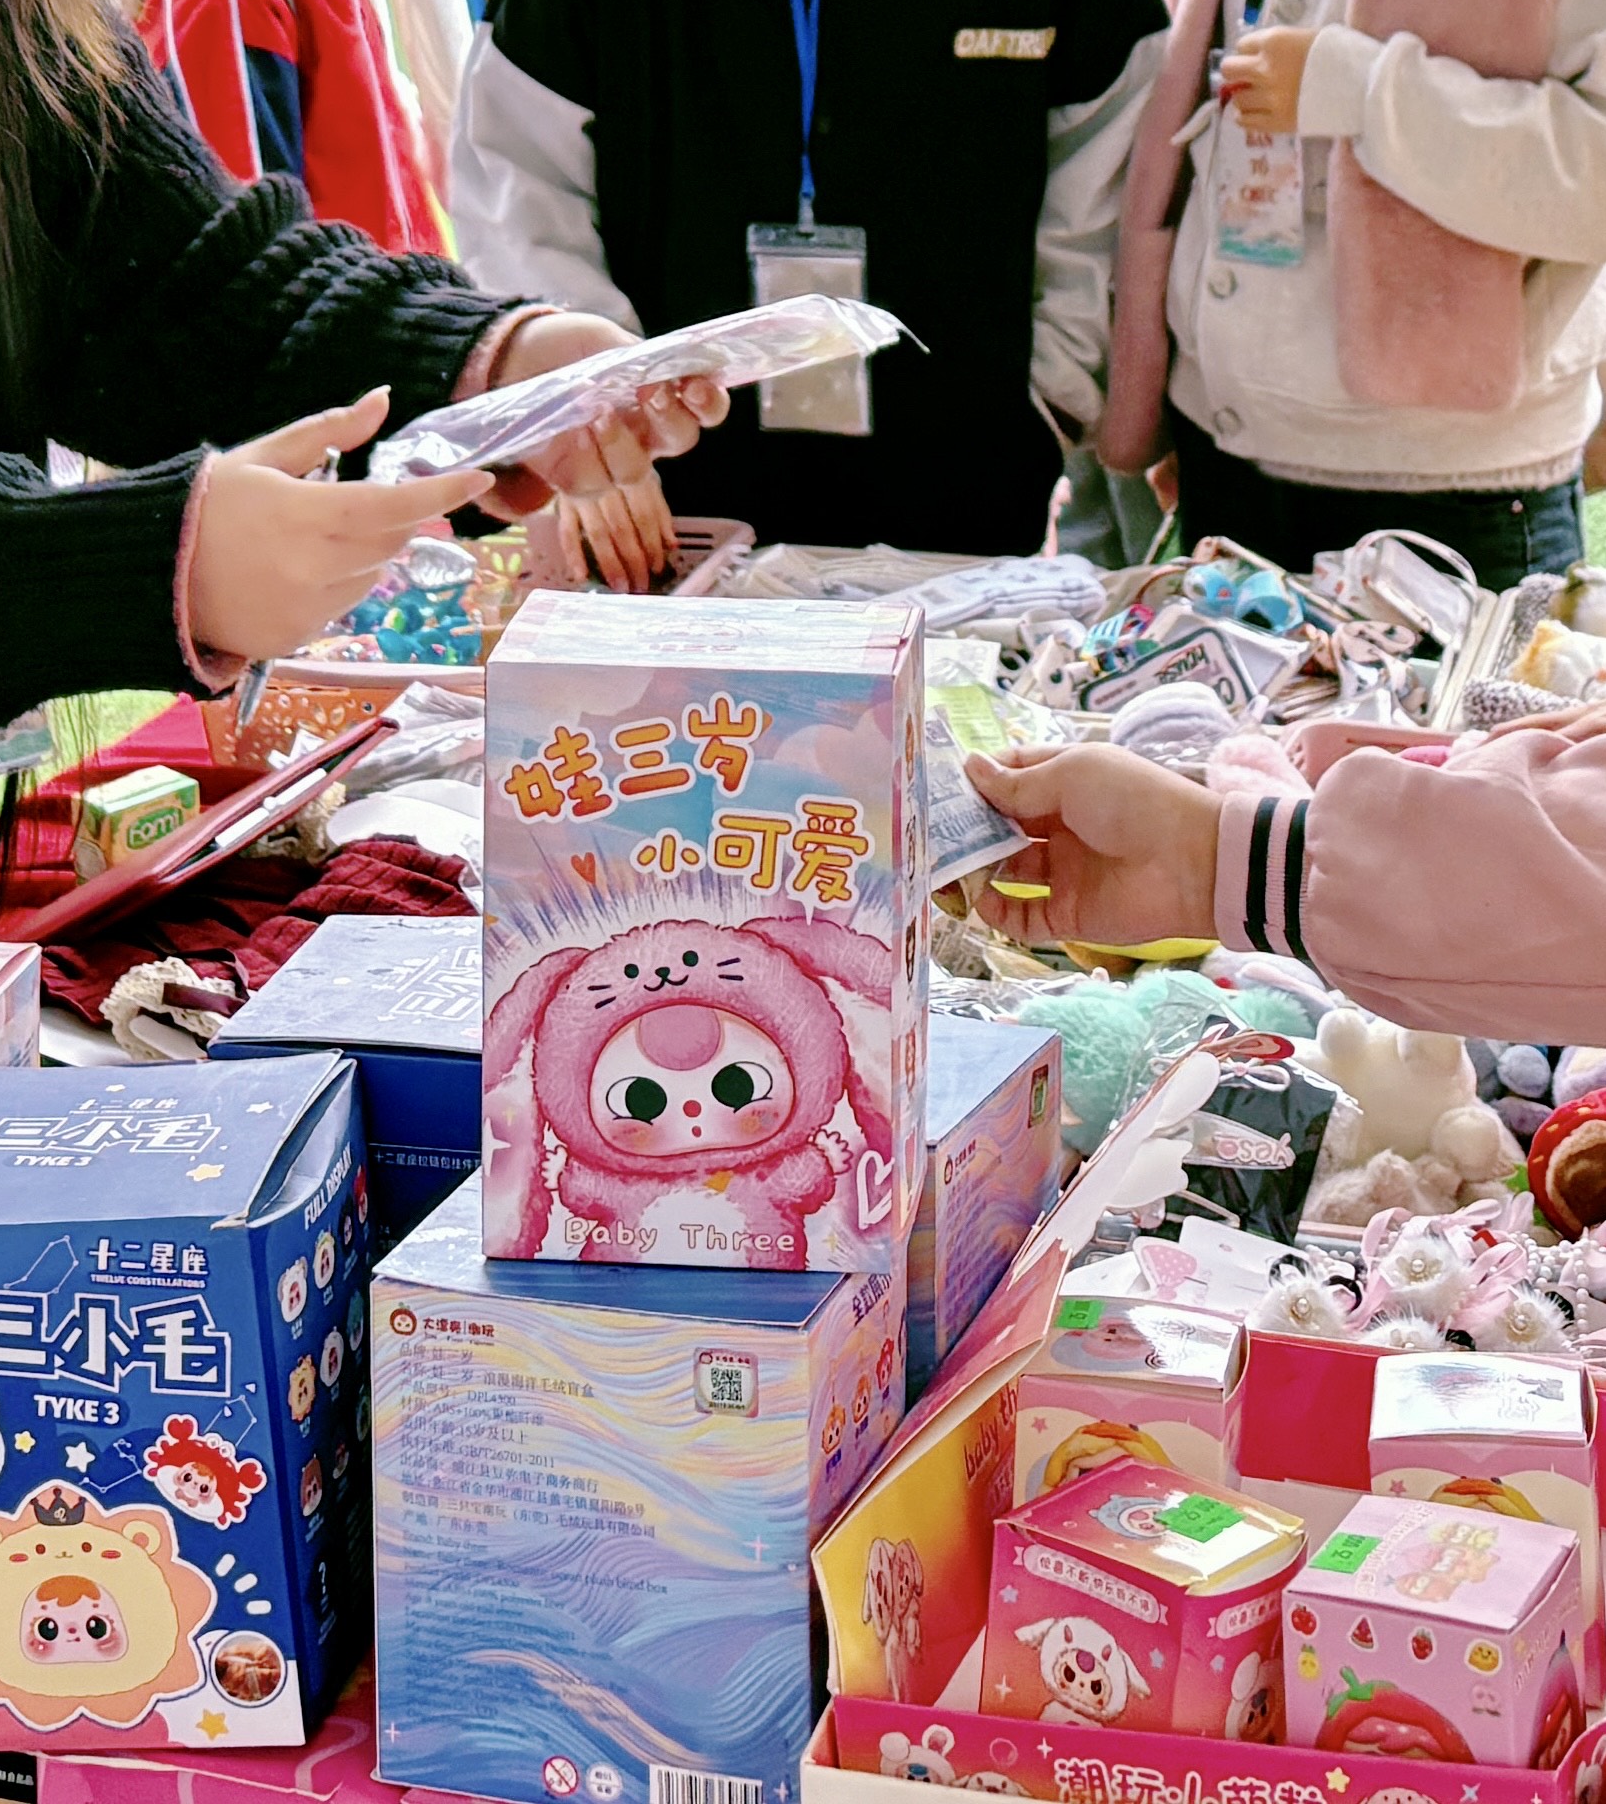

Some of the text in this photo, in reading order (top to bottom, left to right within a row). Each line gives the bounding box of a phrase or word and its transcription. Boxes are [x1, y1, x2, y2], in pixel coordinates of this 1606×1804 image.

[504, 696, 758, 819] 娃三岁
[636, 799, 870, 904] 小可爱
[303, 1195, 328, 1231] FULL
[564, 1216, 795, 1254] Baby Three
[88, 1237, 209, 1276] 十二星座
[33, 1394, 121, 1425] TYKE 3
